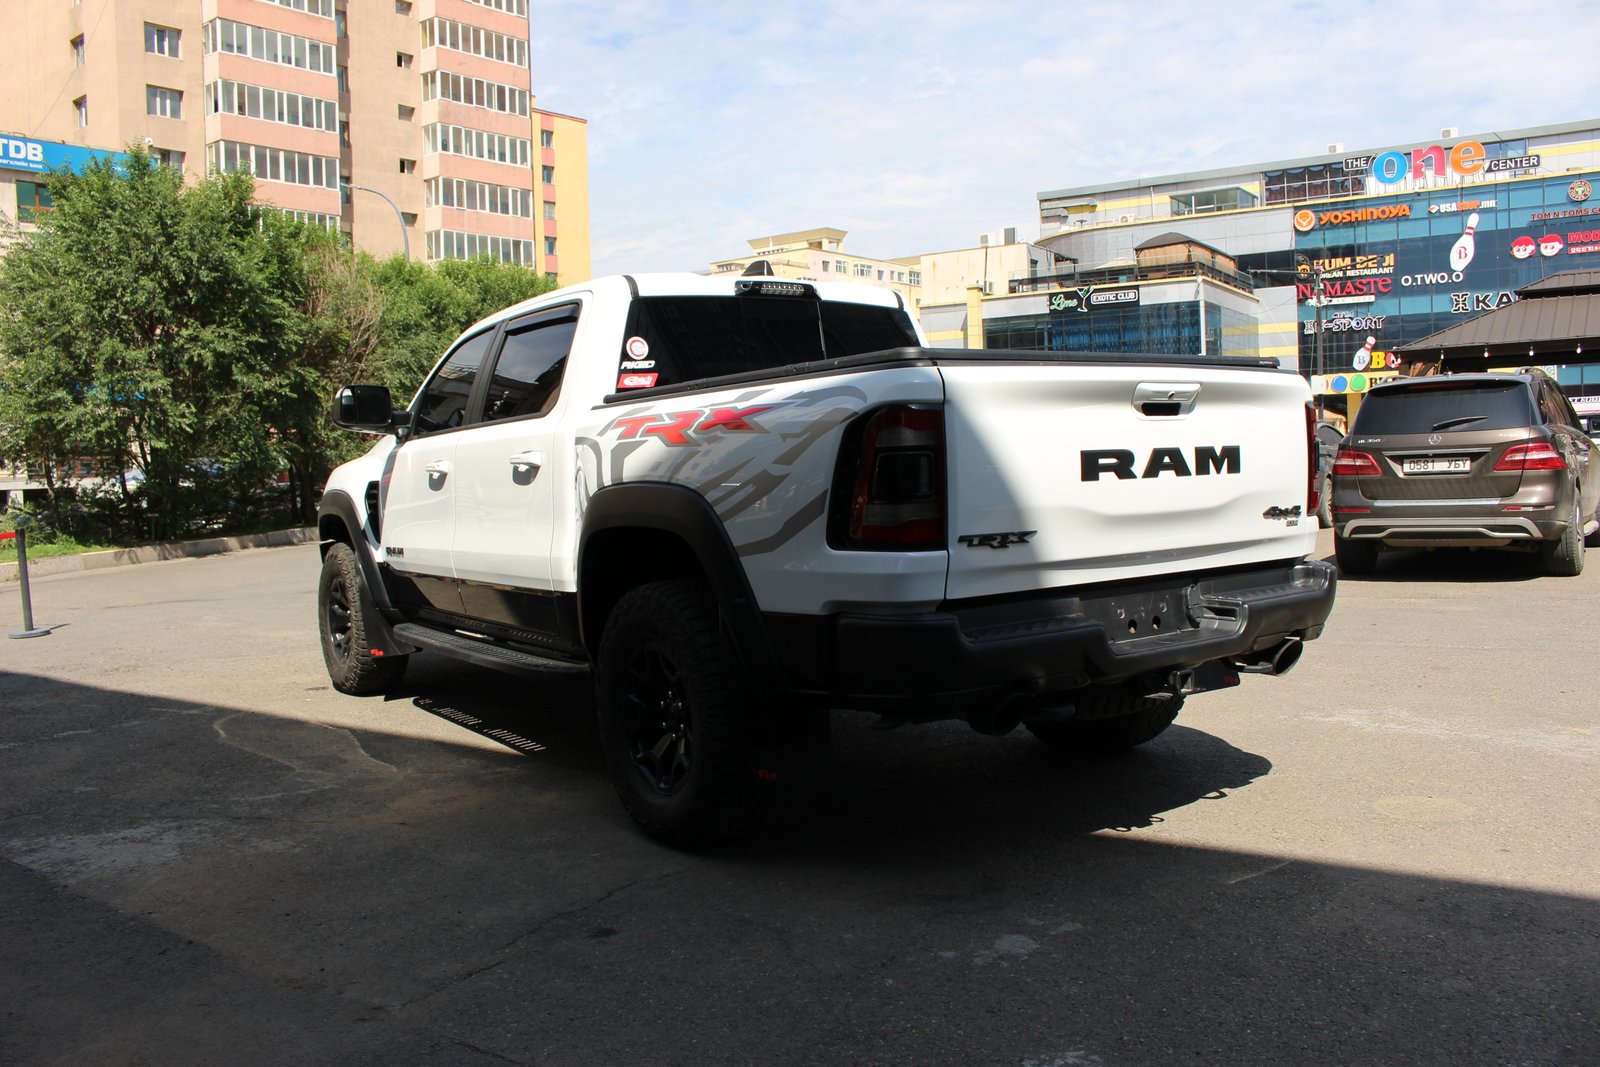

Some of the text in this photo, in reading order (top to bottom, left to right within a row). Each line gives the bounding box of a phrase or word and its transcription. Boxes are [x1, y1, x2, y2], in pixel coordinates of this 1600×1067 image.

[0, 138, 43, 161] TDB
[1347, 140, 1538, 184] THE one CENTER
[1319, 204, 1411, 225] YOSHINOYA
[1562, 208, 1589, 217] TOMS
[1313, 267, 1394, 280] REAN RESTAURANT
[1401, 271, 1464, 287] O.TWO.O
[1050, 291, 1136, 311] Lime EXOTIC CLUB
[1474, 292, 1520, 311] KA
[621, 360, 656, 370] RIGID
[1080, 445, 1241, 482] RAM
[1409, 459, 1435, 470] 0581
